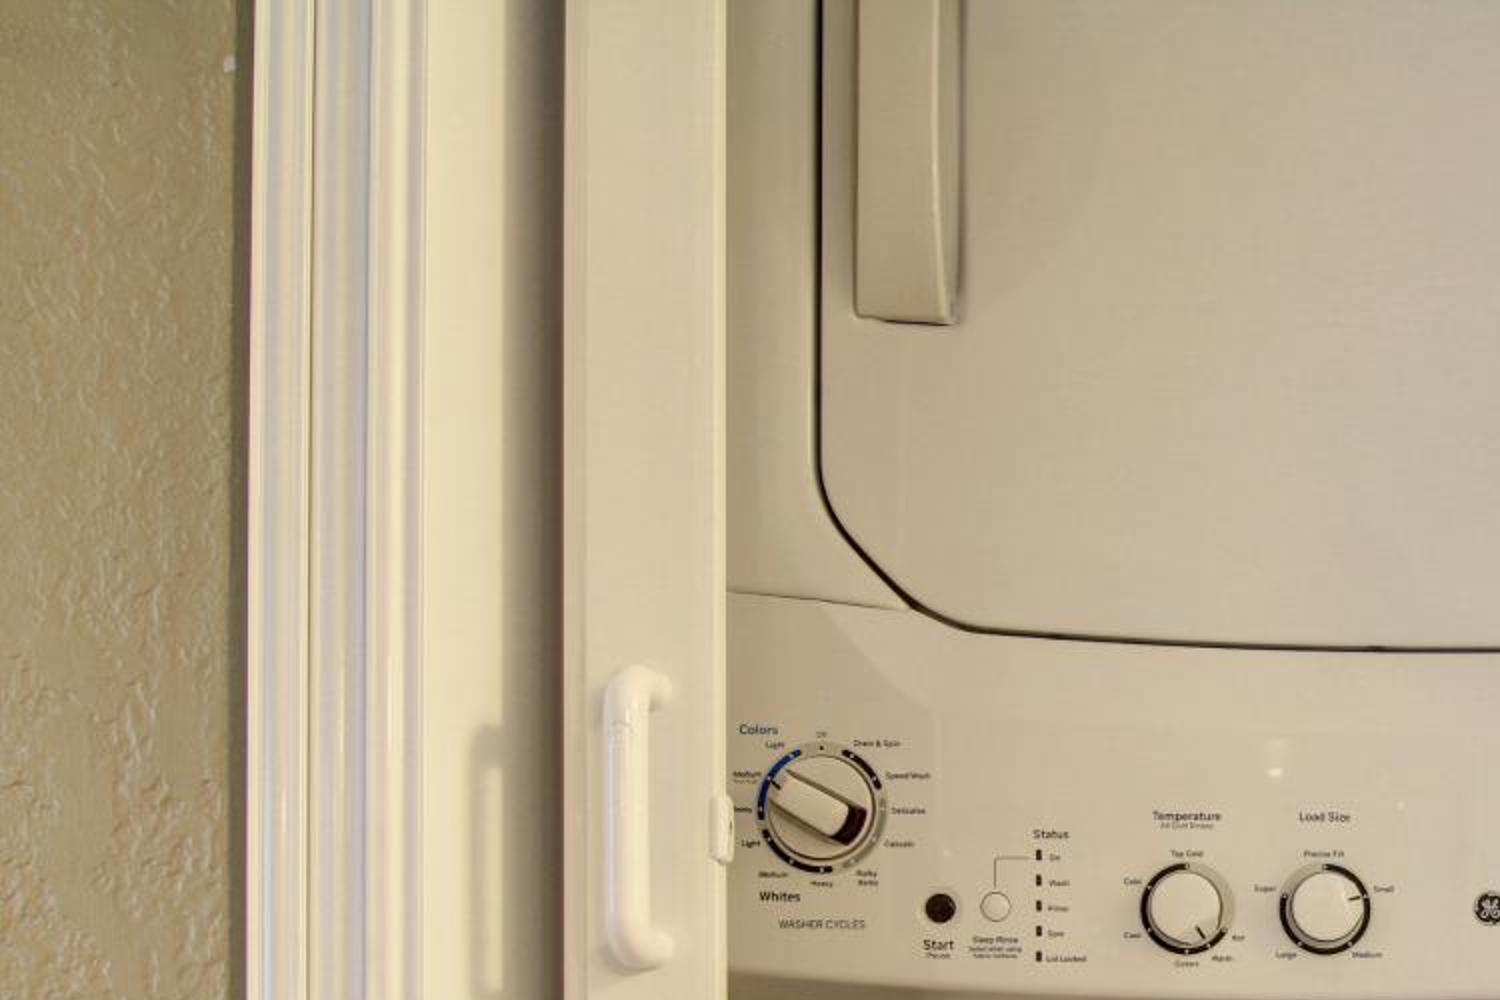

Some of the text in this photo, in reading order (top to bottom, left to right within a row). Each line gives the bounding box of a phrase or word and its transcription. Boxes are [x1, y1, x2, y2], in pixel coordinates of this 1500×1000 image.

[739, 723, 779, 736] Colors
[1152, 810, 1222, 823] Temperature
[1299, 812, 1351, 823] Load Size
[1033, 829, 1070, 840] Status
[759, 891, 801, 903] Whites
[778, 919, 866, 930] WASHER CYCLES
[923, 940, 955, 951] Start
